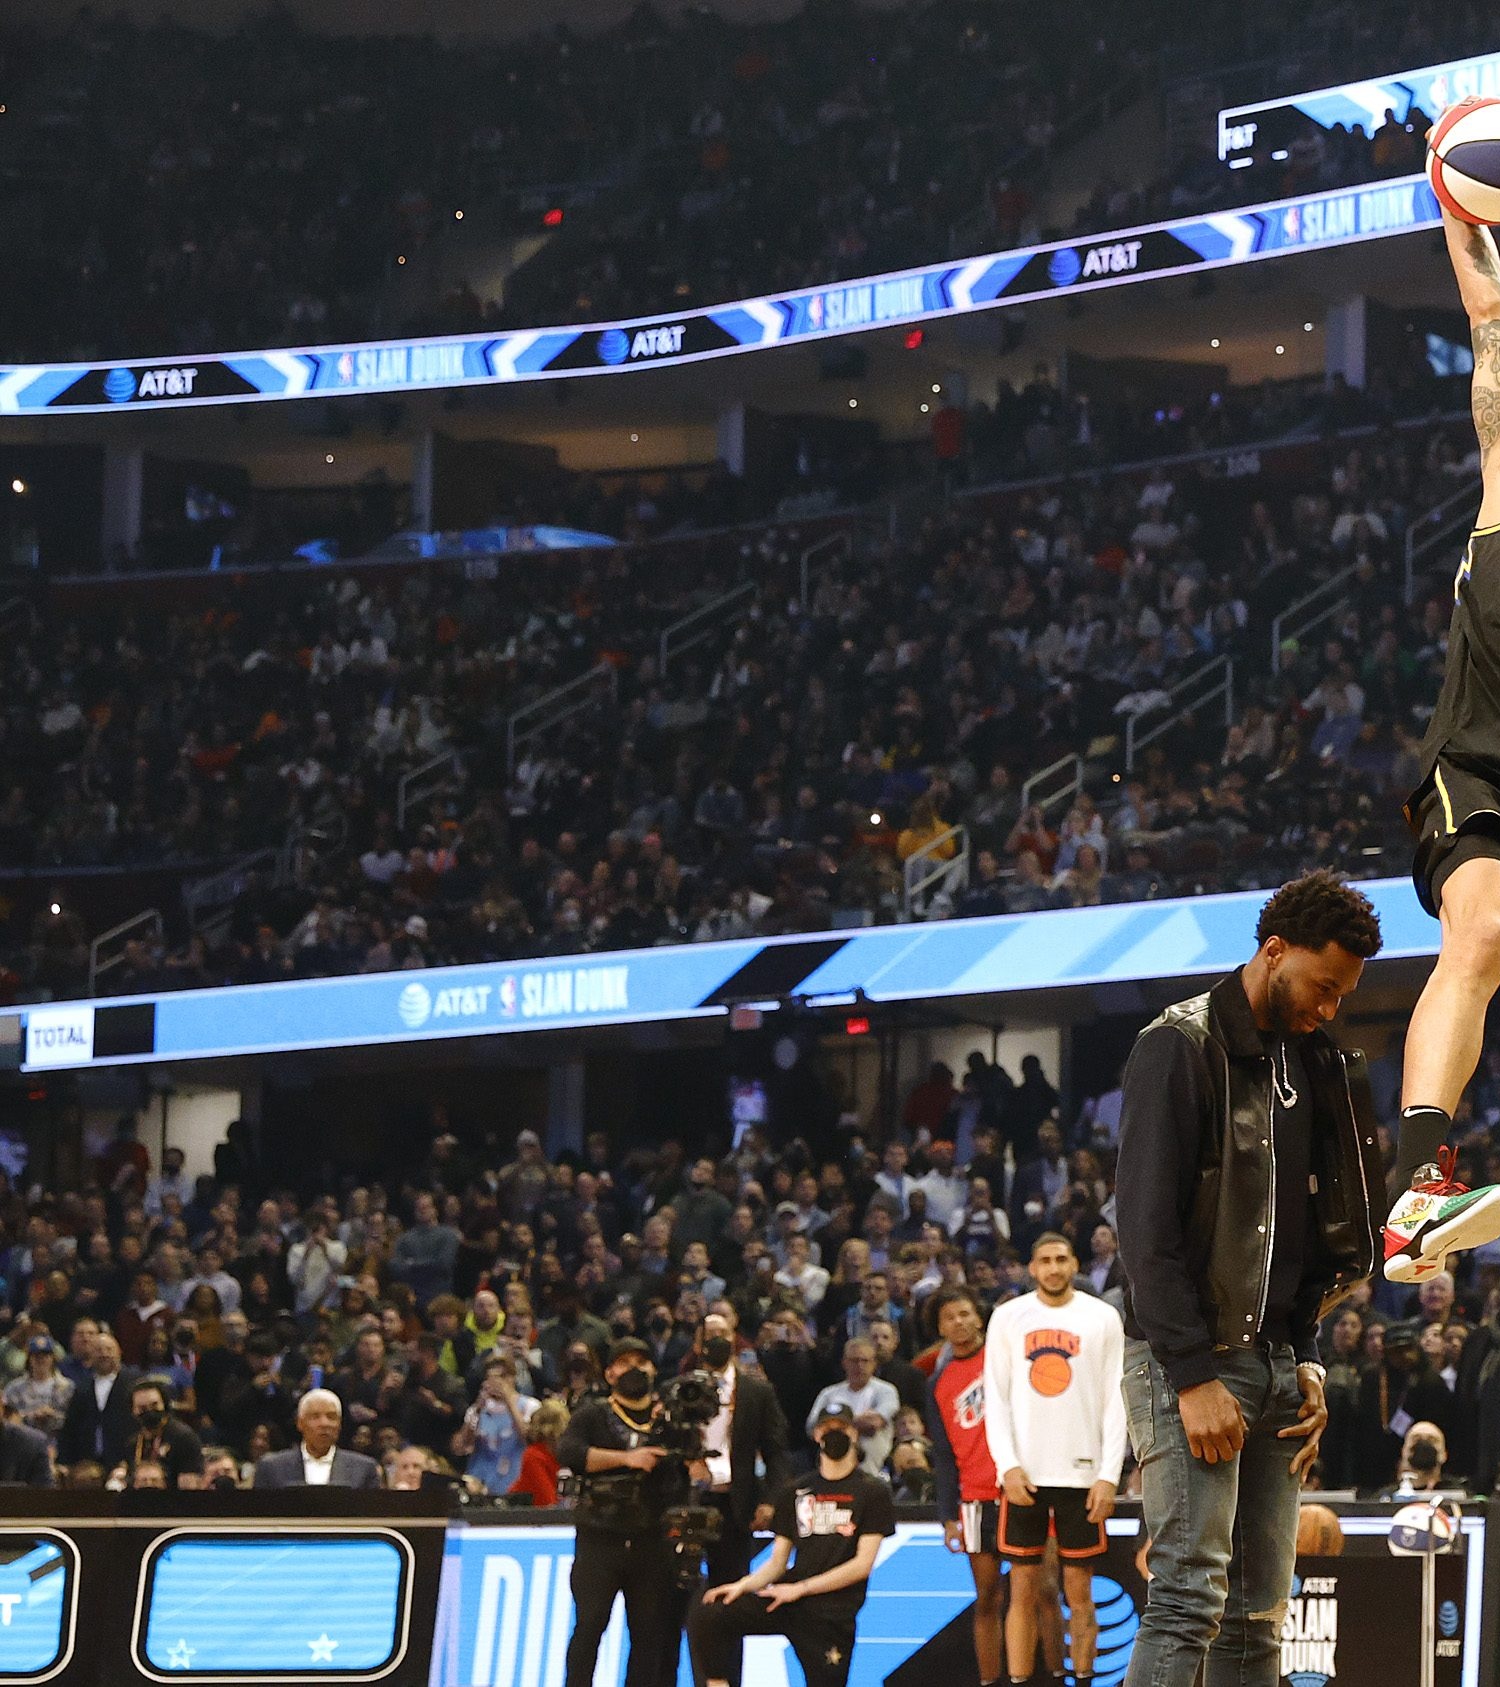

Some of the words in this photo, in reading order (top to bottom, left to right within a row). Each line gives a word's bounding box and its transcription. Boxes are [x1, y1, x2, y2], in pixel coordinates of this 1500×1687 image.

[1082, 240, 1143, 278] AT&T
[630, 324, 687, 359] AT&T
[138, 367, 199, 398] AT&T
[432, 984, 493, 1019] AT&T
[521, 971, 573, 1018] SLAM
[574, 965, 619, 1014] DUNK
[33, 1025, 87, 1049] TOTAL
[1302, 1577, 1338, 1595] AT&T
[1281, 1598, 1338, 1642] SLAM
[1280, 1640, 1337, 1678] DUNK
